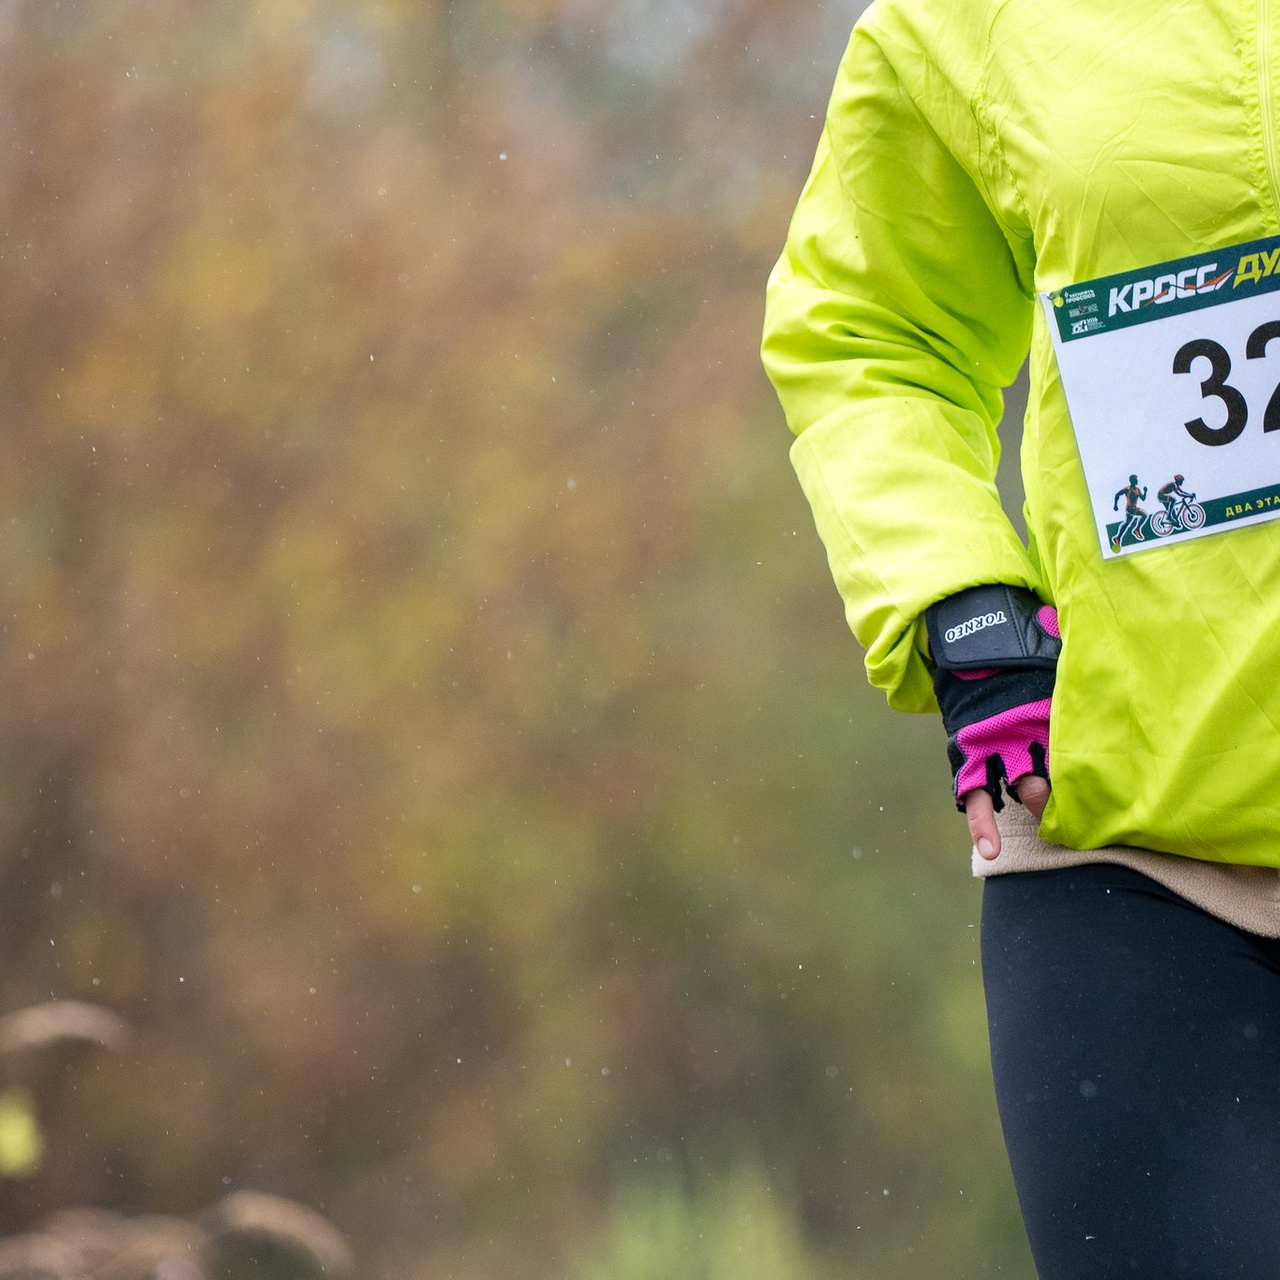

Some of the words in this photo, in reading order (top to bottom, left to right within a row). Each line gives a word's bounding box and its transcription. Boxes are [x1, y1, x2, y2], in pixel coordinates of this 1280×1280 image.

[1108, 263, 1233, 317] КРОСС
[1225, 502, 1253, 517] ДВА
[945, 611, 1007, 643] TORNEO
